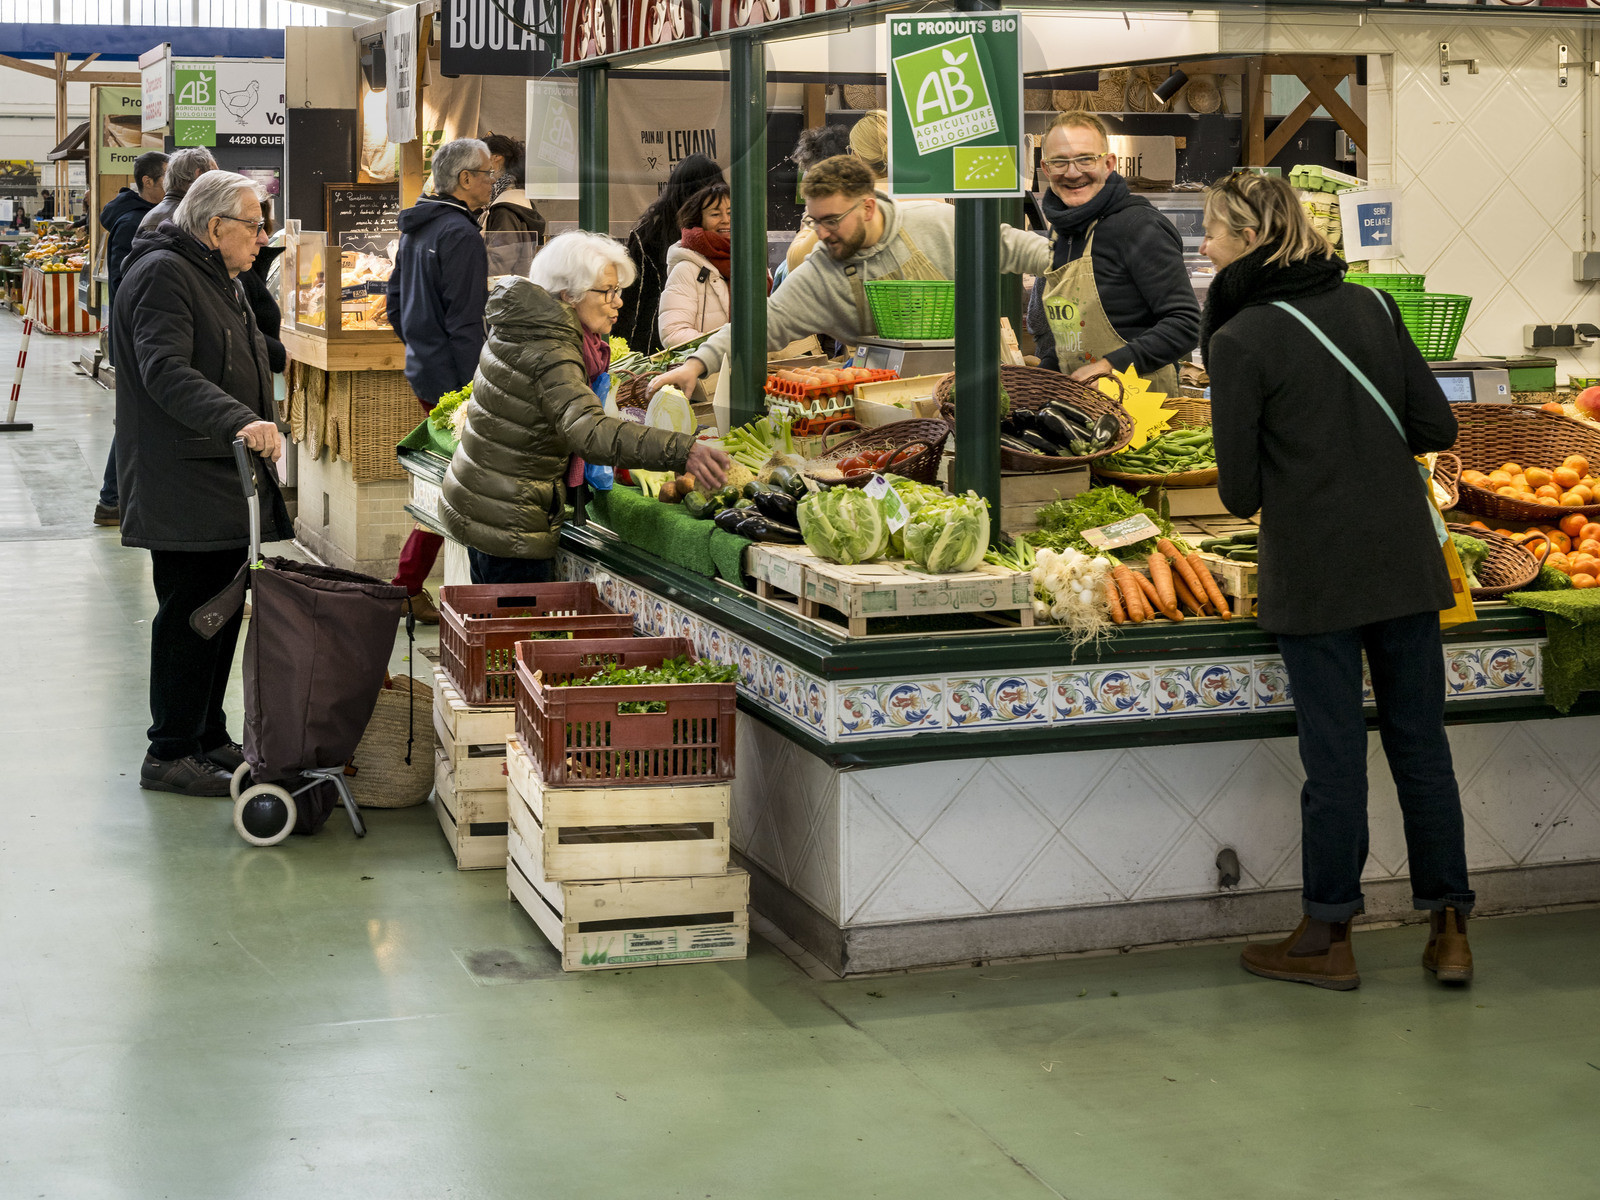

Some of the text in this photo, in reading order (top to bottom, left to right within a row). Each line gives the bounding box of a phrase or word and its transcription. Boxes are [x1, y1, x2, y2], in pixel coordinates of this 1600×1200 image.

[893, 18, 1016, 36] ICI PRODUITS BIO
[178, 80, 210, 104] AB
[916, 66, 974, 122] AB
[916, 108, 993, 138] AGRICULTURE
[228, 135, 257, 145] 44290
[918, 119, 996, 149] BIOLOGIQUE
[641, 129, 717, 161] PAIN AU LEVAIN
[1373, 207, 1386, 215] SENS
[1364, 218, 1374, 226] DE
[1375, 218, 1381, 226] LA
[1047, 304, 1074, 320] BIO
